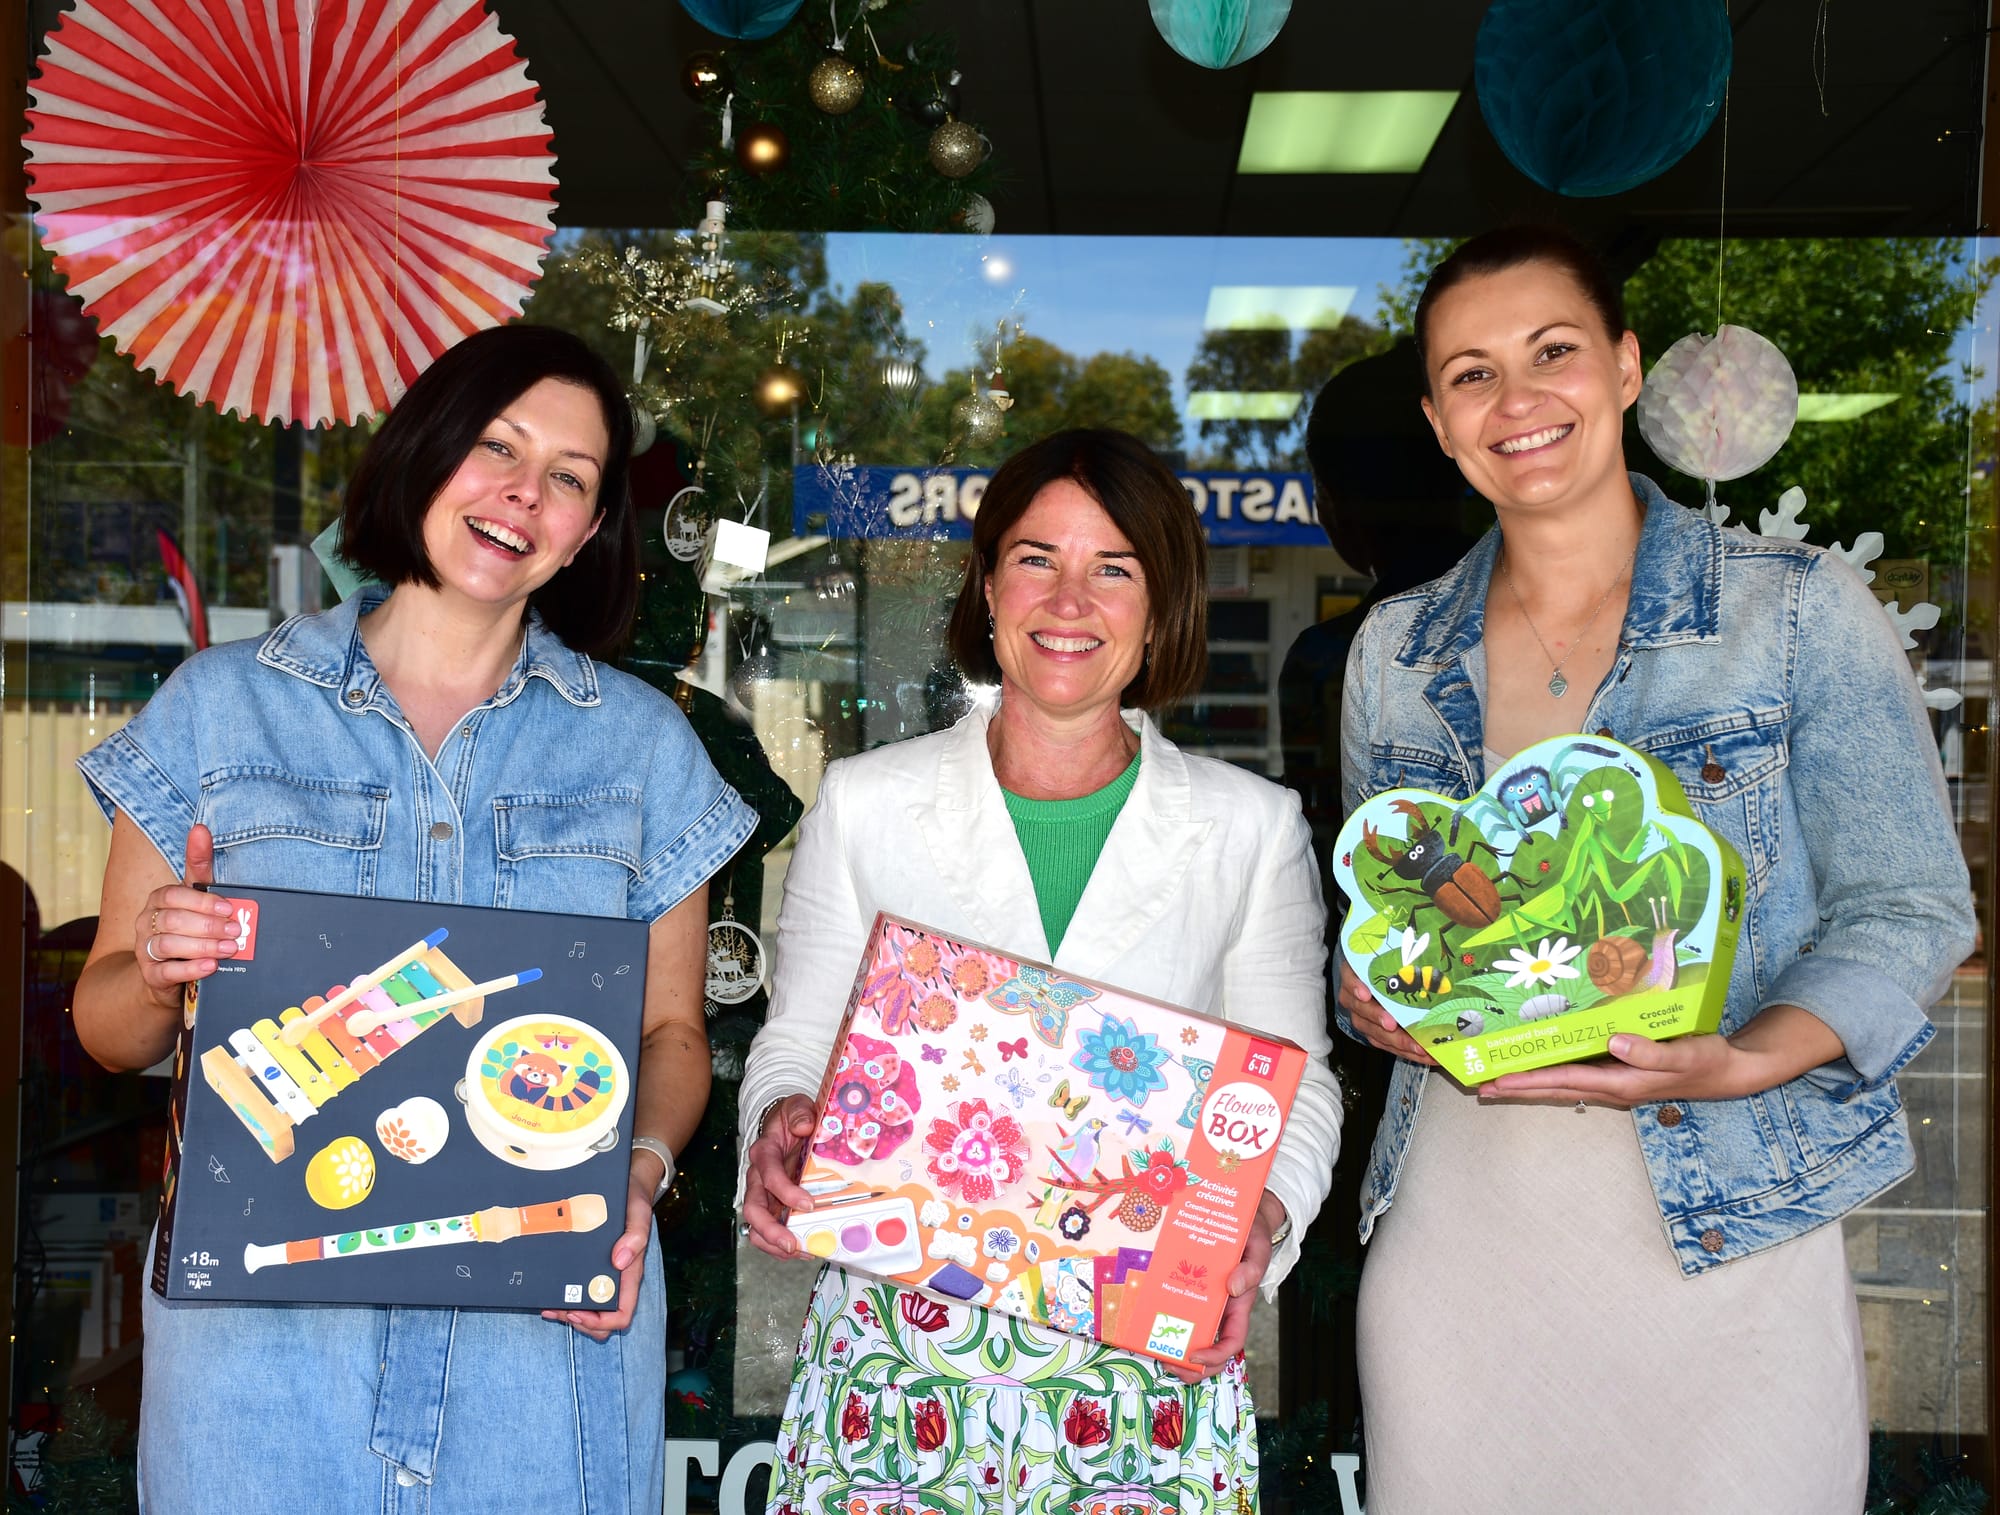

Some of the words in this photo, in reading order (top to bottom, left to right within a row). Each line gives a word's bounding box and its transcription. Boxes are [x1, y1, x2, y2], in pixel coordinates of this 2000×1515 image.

[1639, 1003, 1685, 1021] Crocodile
[1648, 1014, 1678, 1030] Creek
[1486, 1030, 1532, 1049] backyard
[1533, 1025, 1559, 1040] bugs
[1488, 1035, 1548, 1063] FLOOR
[1552, 1021, 1617, 1048] PUZZLE
[1252, 1053, 1273, 1063] AGES
[1248, 1061, 1270, 1076] 6-10
[1464, 1059, 1486, 1076] 36
[1213, 1092, 1277, 1118] Flower
[1208, 1112, 1269, 1150] BOX
[1200, 1179, 1239, 1197] Activités
[1196, 1191, 1236, 1208] créatives
[181, 1251, 220, 1266] +18m
[187, 1271, 210, 1279] DESIGN
[188, 1279, 212, 1290] FRANCE
[1149, 1340, 1184, 1358] DJECO
